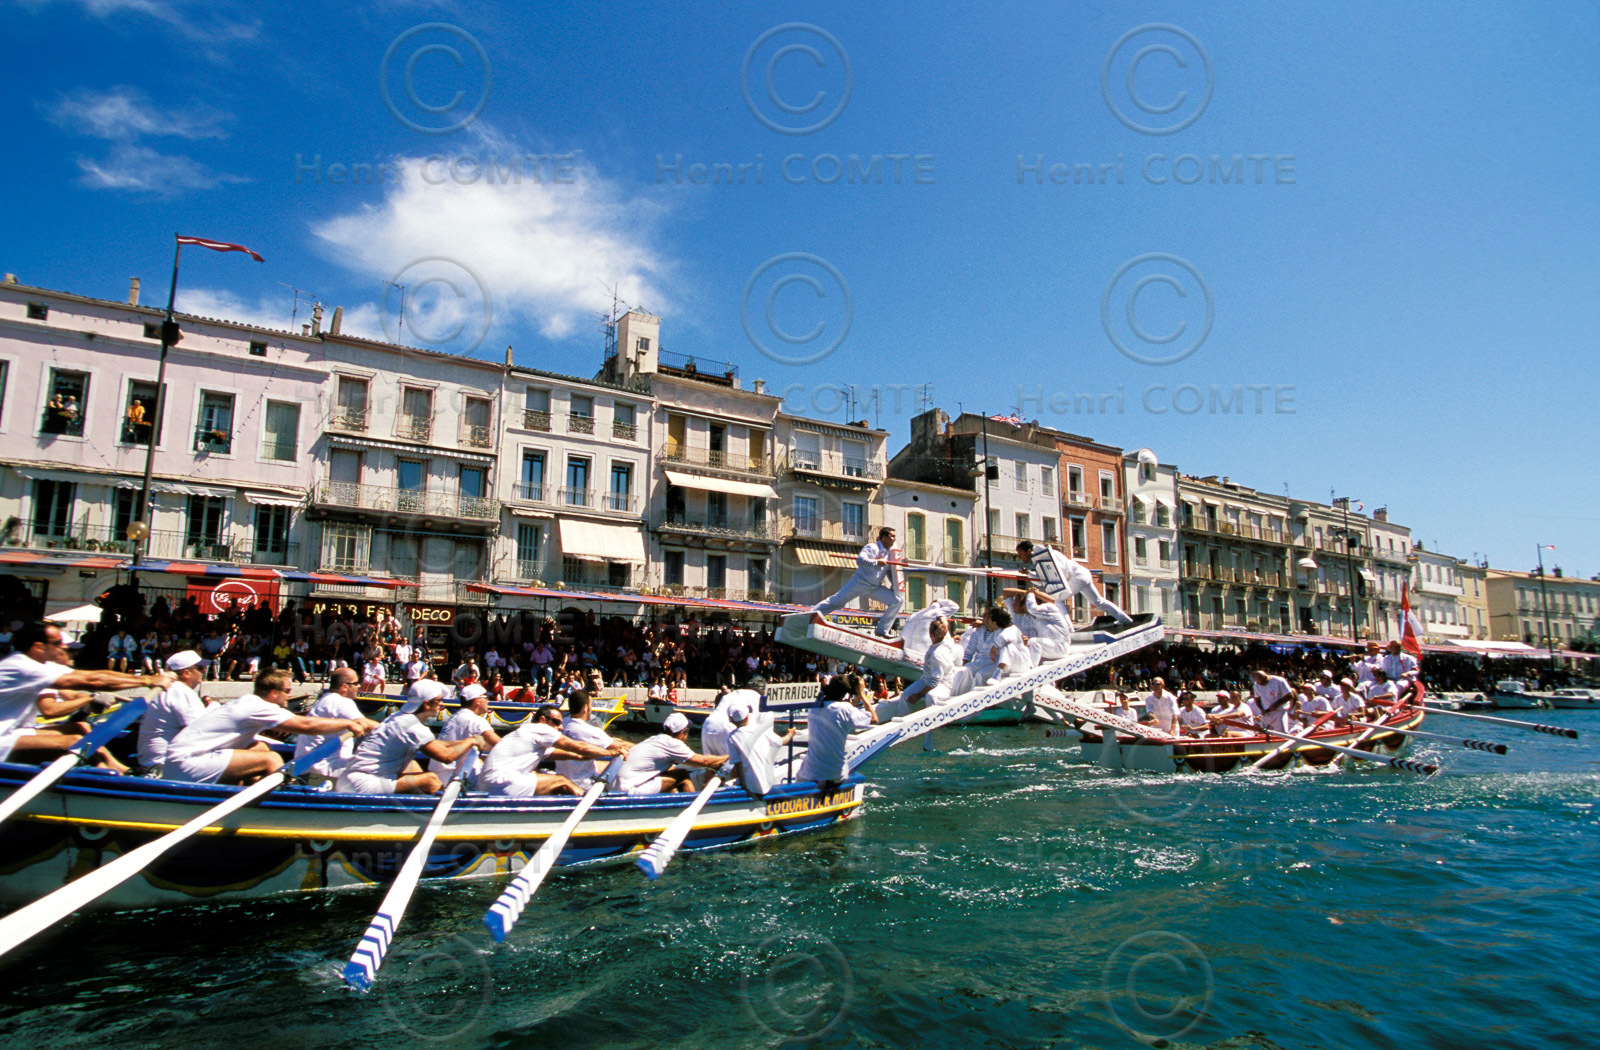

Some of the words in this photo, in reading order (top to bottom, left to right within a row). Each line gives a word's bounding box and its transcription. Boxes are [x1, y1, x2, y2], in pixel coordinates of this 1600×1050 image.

[411, 608, 451, 621] DECO
[821, 628, 851, 650] VILLE
[854, 638, 868, 653] DE
[766, 685, 819, 701] ANTRAIGUE
